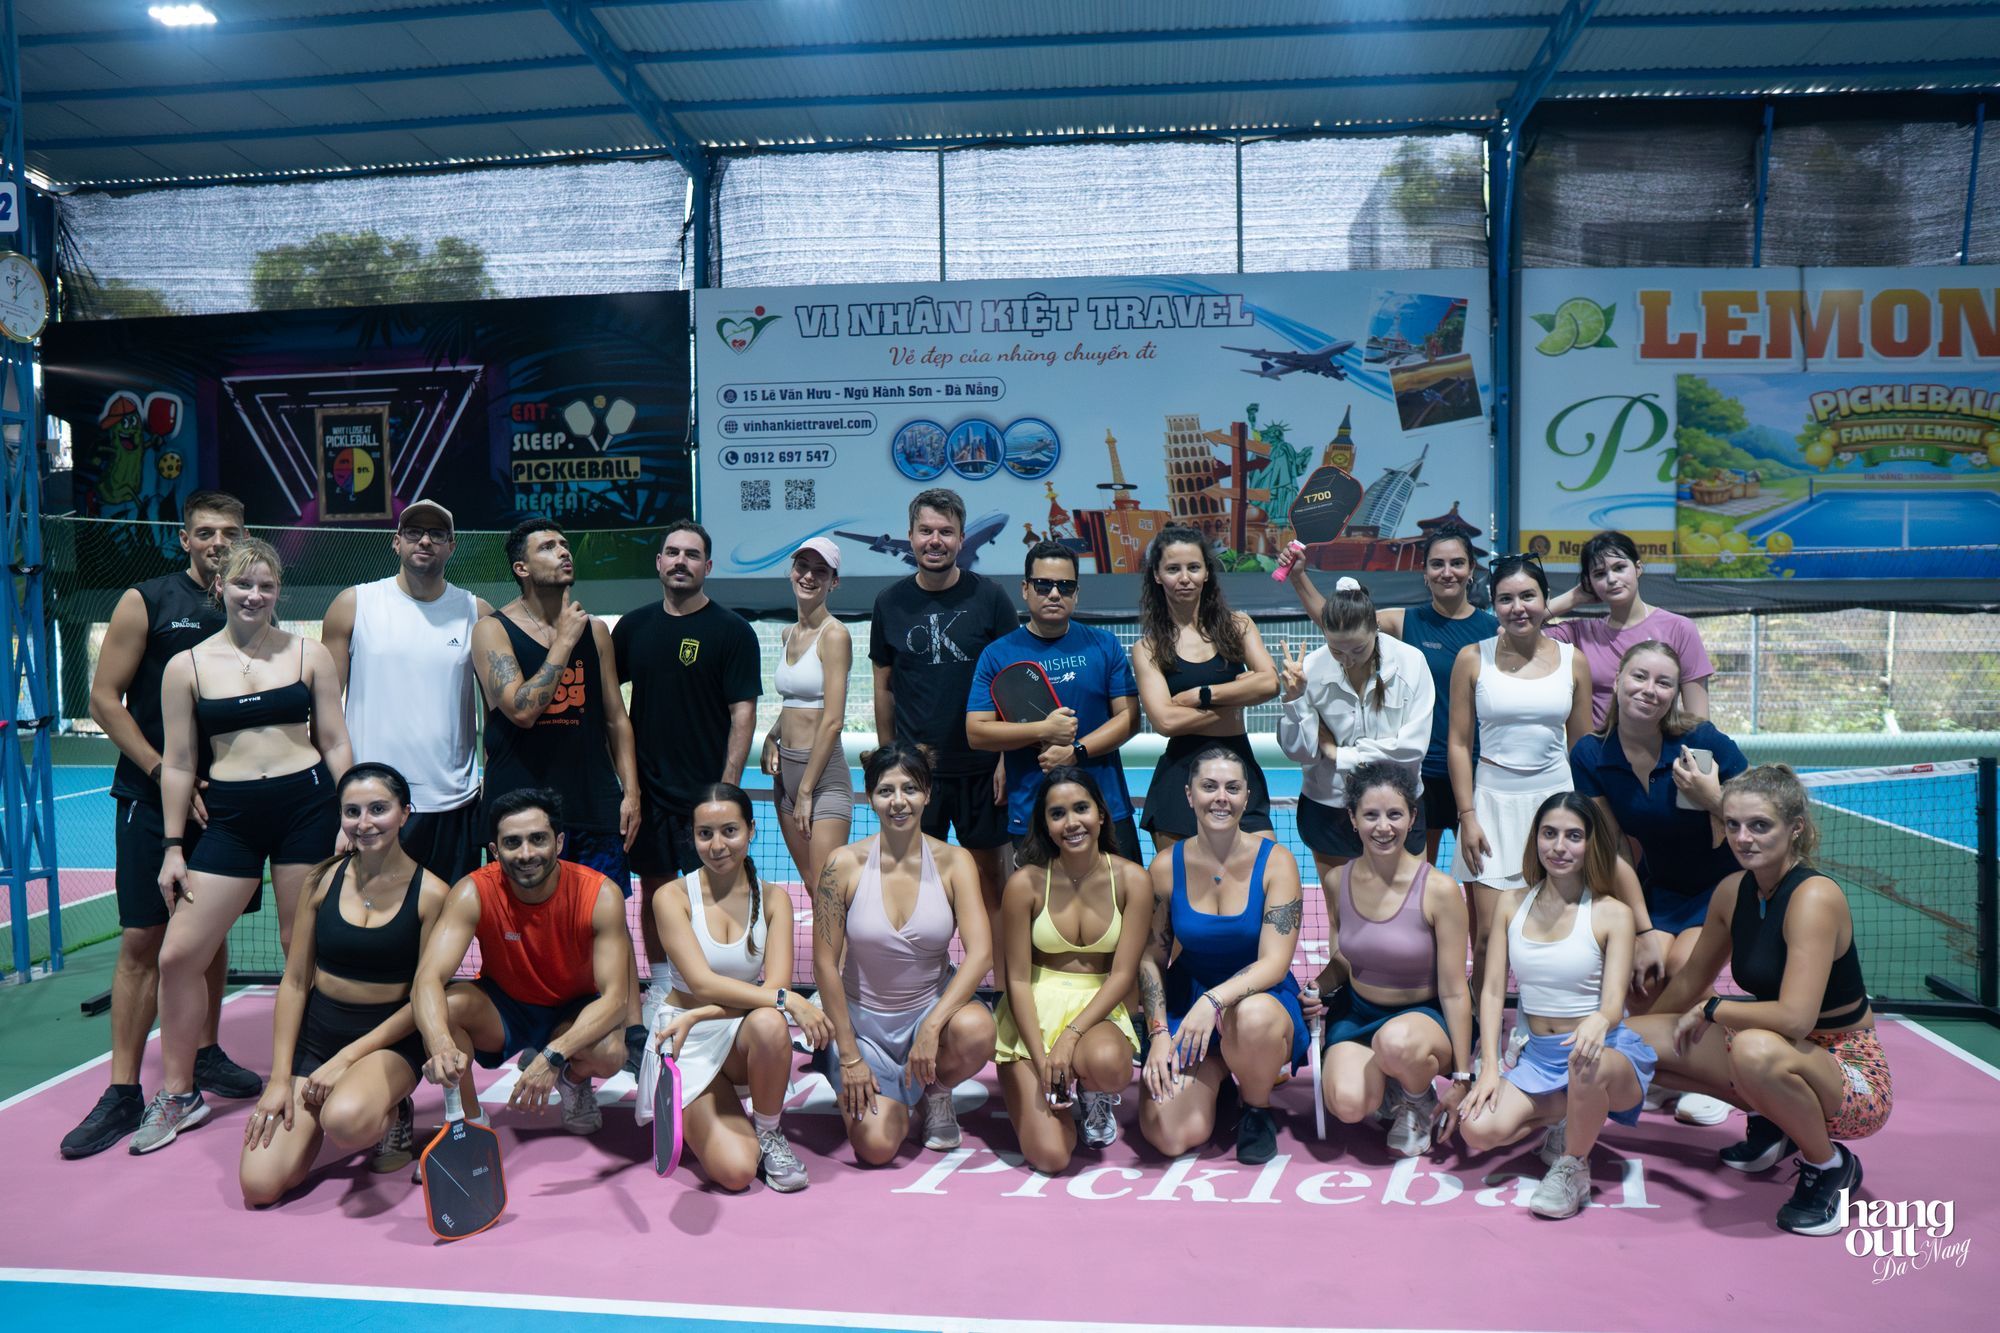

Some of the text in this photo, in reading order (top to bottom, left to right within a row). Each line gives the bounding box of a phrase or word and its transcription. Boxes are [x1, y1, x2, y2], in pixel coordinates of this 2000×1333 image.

[795, 291, 1254, 338] VI NHÂN KIỆT TRAVEL
[1638, 288, 2000, 360] LEMON
[889, 341, 1157, 368] Vẻ đẹp của những chuyến đi
[743, 389, 757, 401] 15
[762, 388, 776, 401] Lê
[780, 387, 803, 400] Văn
[844, 387, 869, 402] Ngũ
[873, 385, 905, 398] Hành
[909, 385, 932, 397] Sơn
[945, 383, 961, 396] Đà
[966, 381, 999, 399] Nẵng
[743, 418, 872, 432] vinhankiettravel.com
[1840, 424, 1983, 445] FAMILY LEMON
[325, 433, 380, 448] PICKLEBALL
[512, 432, 574, 452] SLEEP.
[743, 450, 829, 464] 0912 697 547
[513, 459, 640, 481] PICKLEBALL.
[1304, 490, 1332, 504] T700
[560, 660, 584, 685] oi
[1038, 655, 1087, 672] NISHER
[1026, 668, 1040, 682] T700
[891, 1147, 1663, 1209] Picklebal
